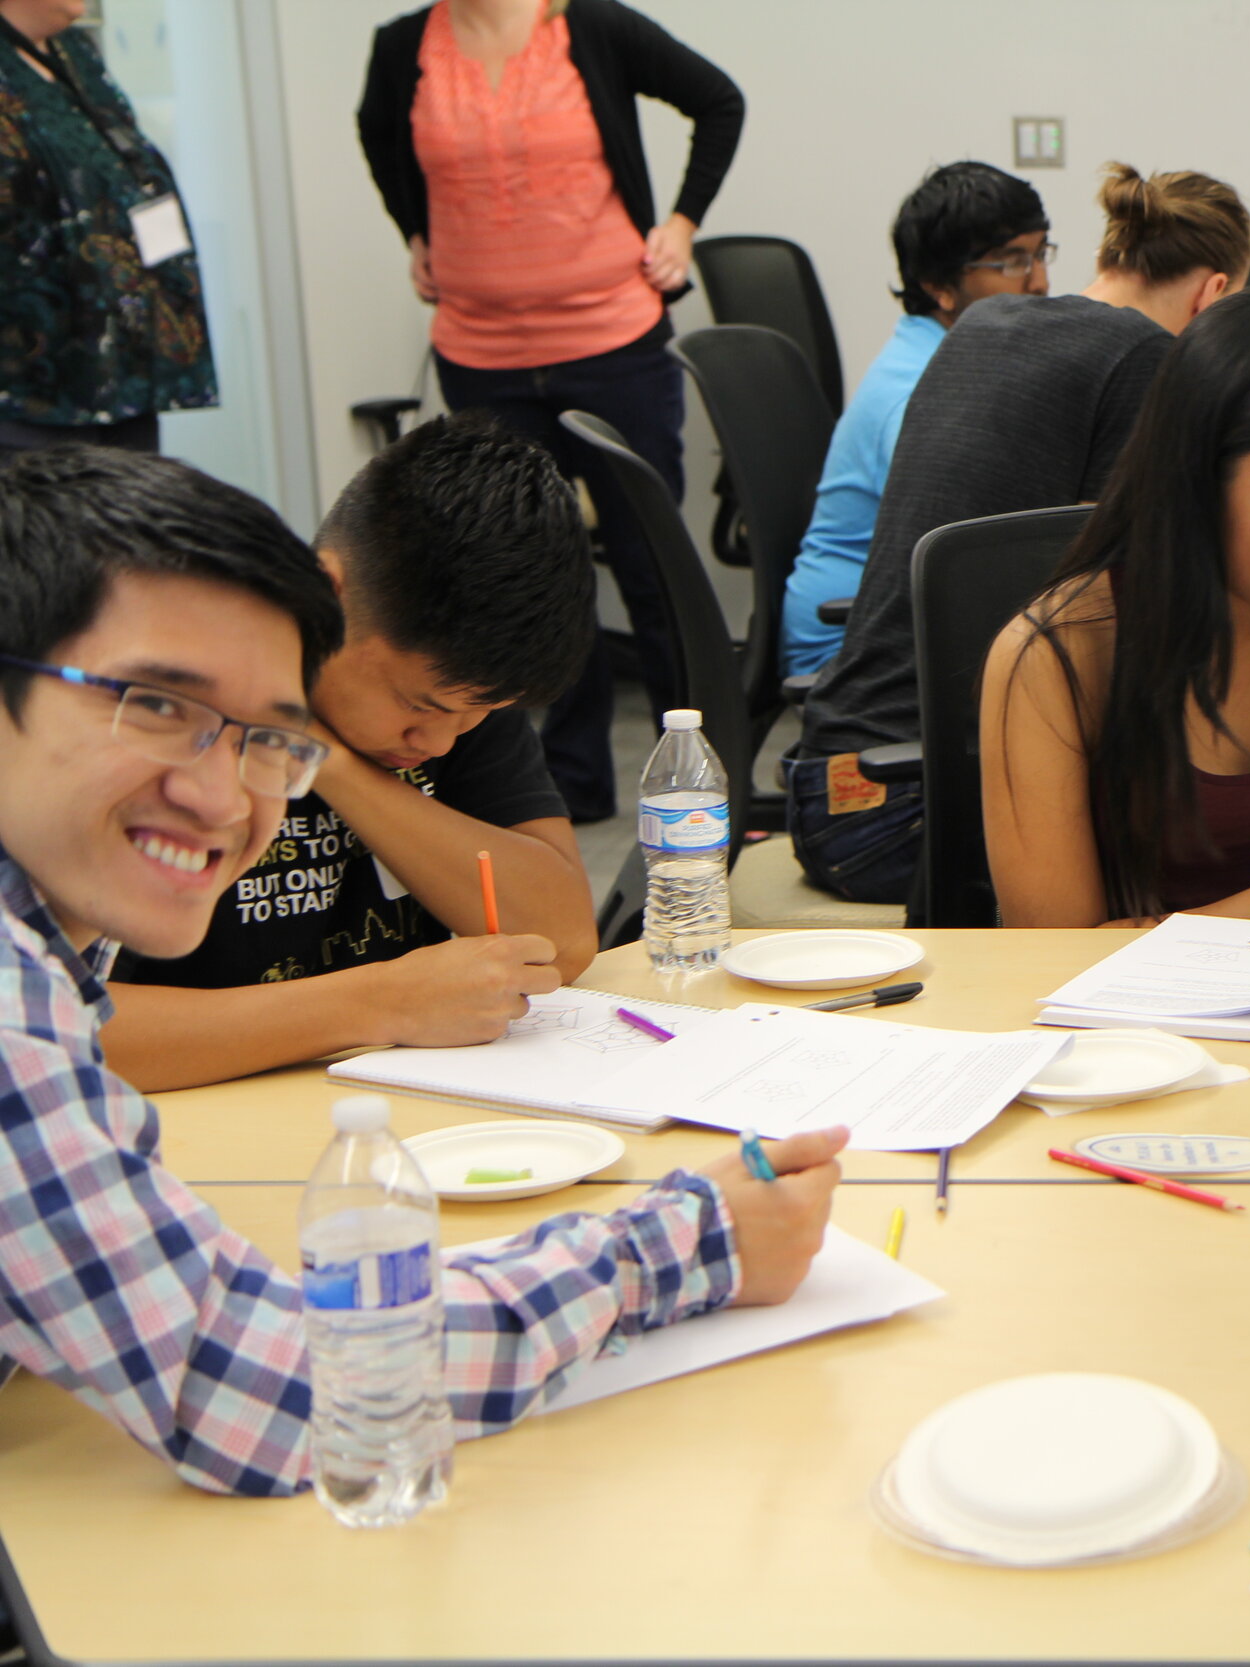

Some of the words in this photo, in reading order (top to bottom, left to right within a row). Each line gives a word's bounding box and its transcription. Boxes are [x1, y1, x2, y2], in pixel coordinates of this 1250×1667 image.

[303, 835, 339, 859] TO
[237, 872, 281, 901] BUT
[285, 859, 348, 891] ONLY
[236, 900, 272, 924] TO
